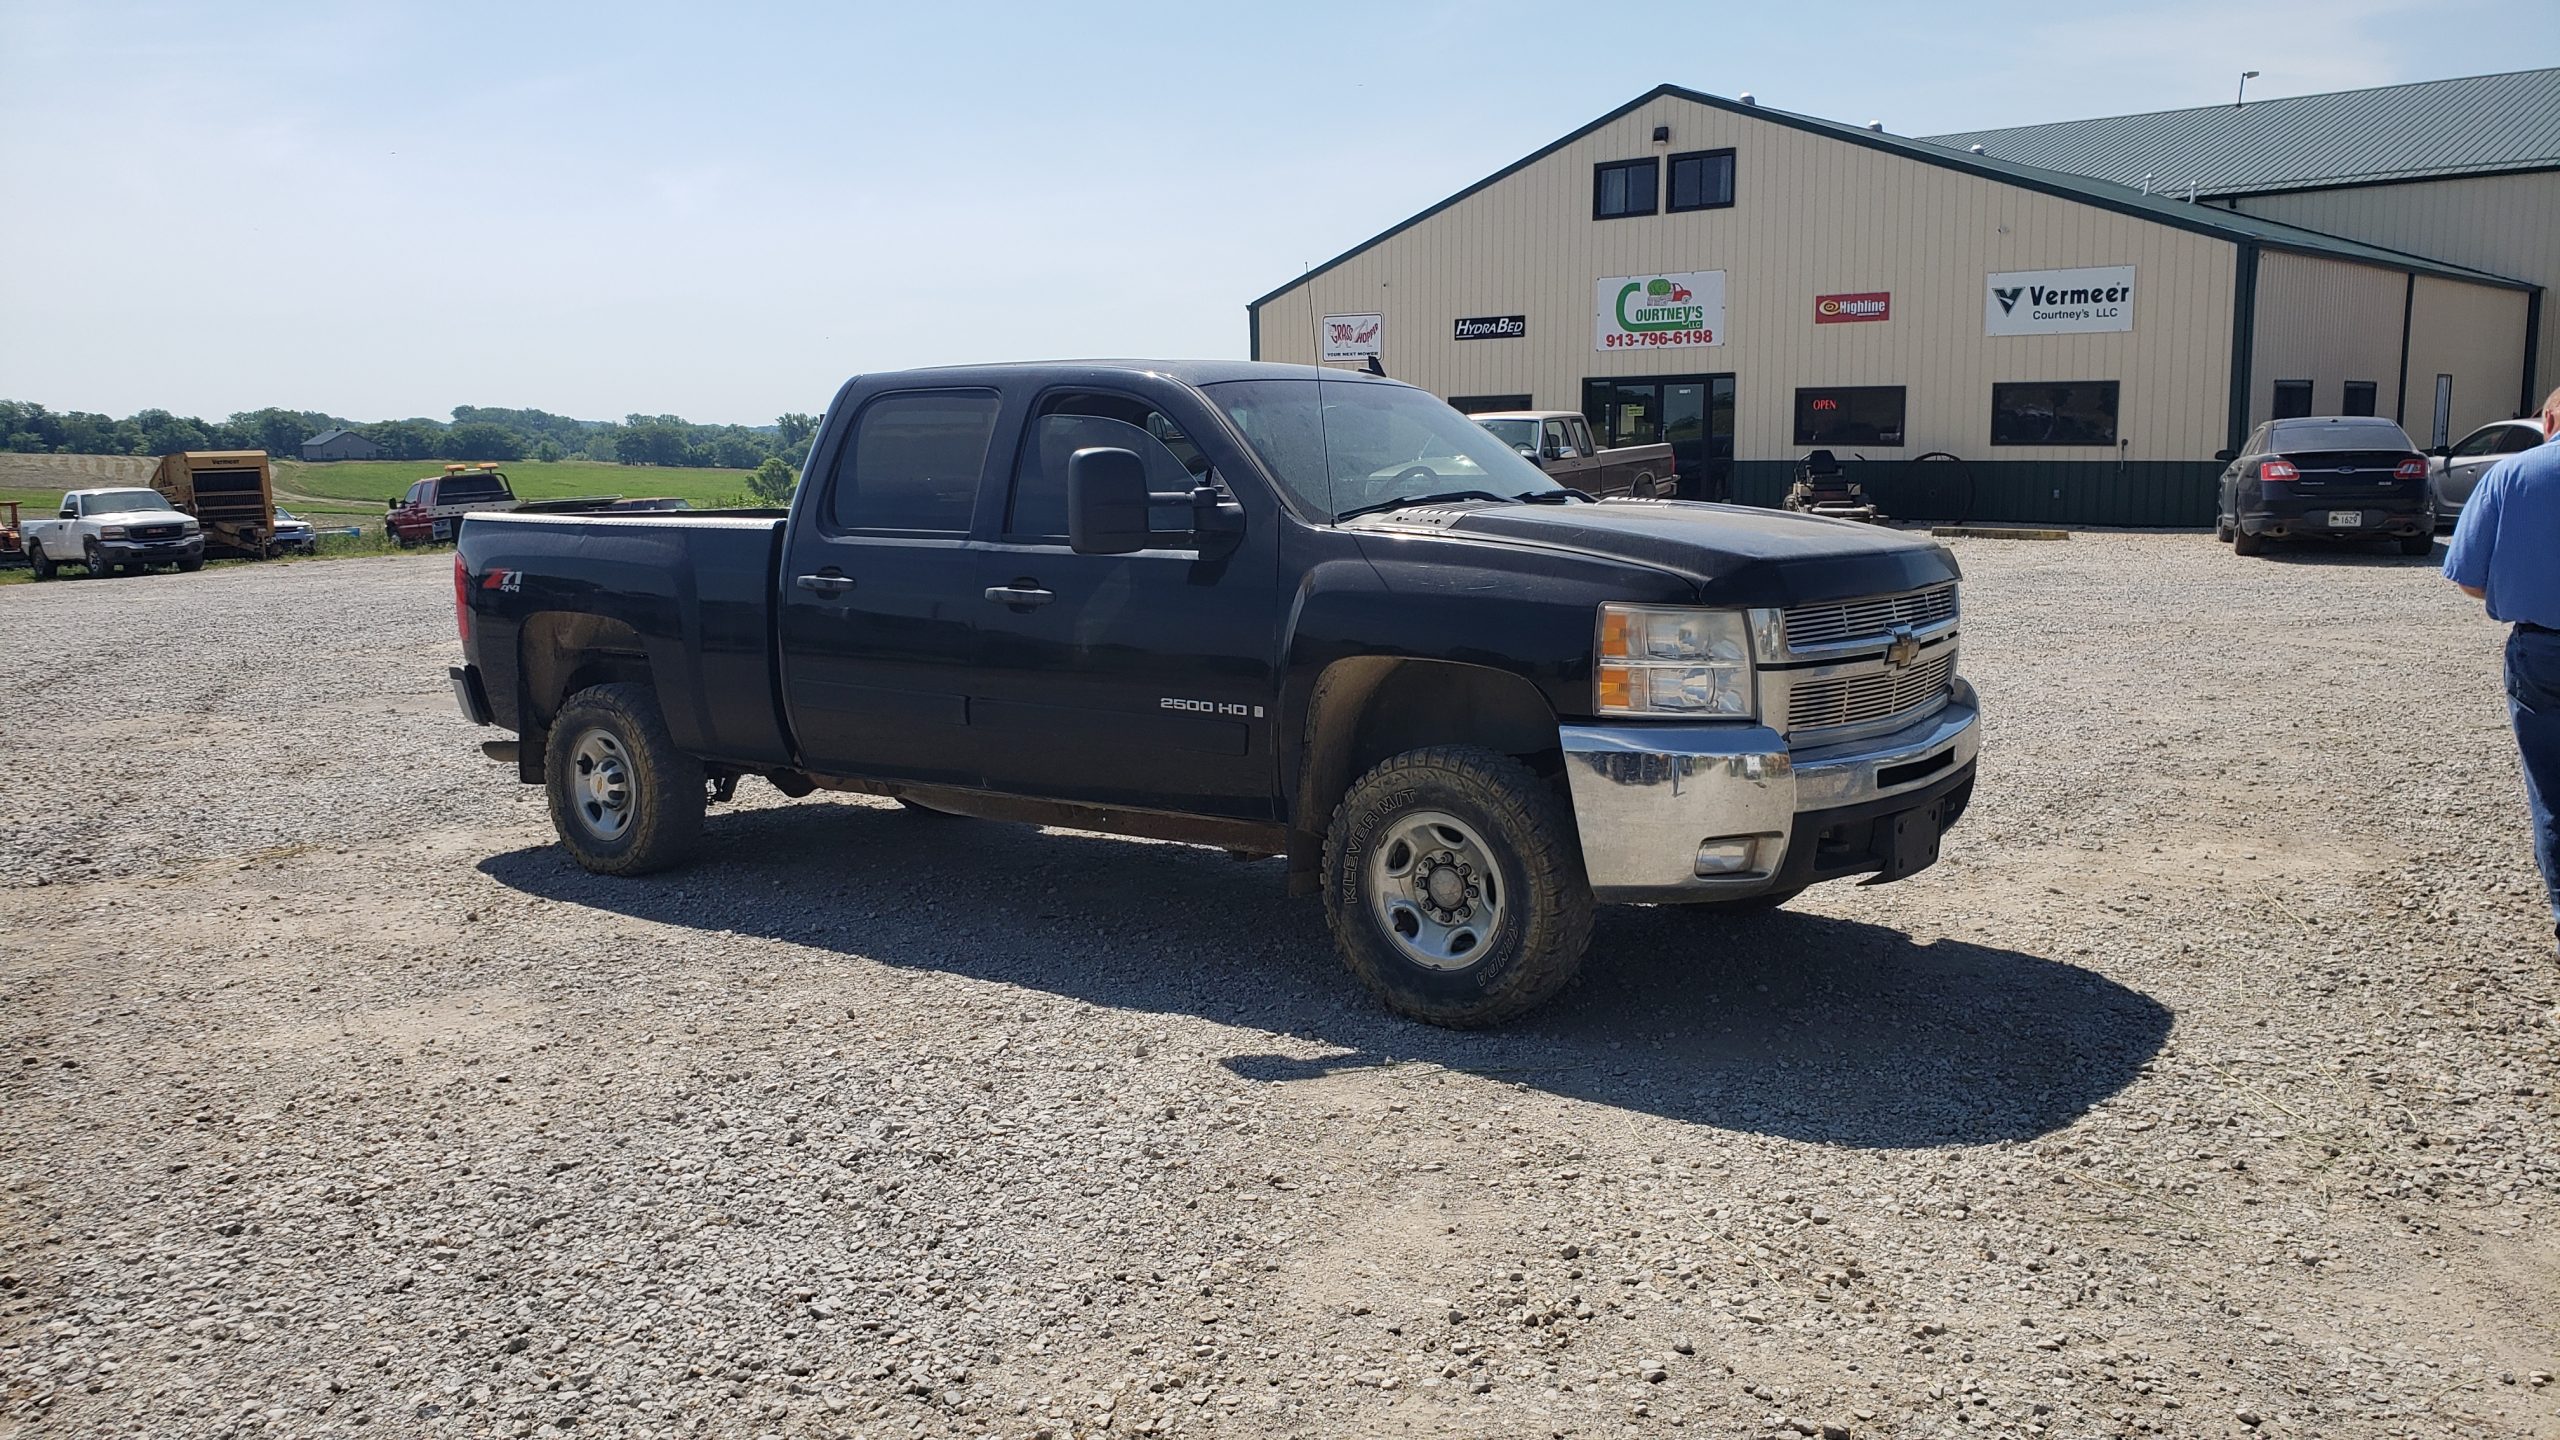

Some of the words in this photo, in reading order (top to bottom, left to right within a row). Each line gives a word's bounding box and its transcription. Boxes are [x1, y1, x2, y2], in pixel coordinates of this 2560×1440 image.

[2030, 286, 2129, 306] Vermeer
[1840, 300, 1885, 314] Highline
[2033, 309, 2090, 320] Courtney's
[2096, 308, 2118, 318] LLC
[1331, 324, 1353, 344] GRASS
[1355, 323, 1378, 343] HOPPER
[1606, 330, 1712, 347] 913-796-6198
[1813, 400, 1836, 410] OPEN
[1160, 698, 1213, 712] 2500
[1218, 703, 1247, 715] HD
[1342, 811, 1379, 904] KLEVER
[1378, 789, 1415, 815] M/T
